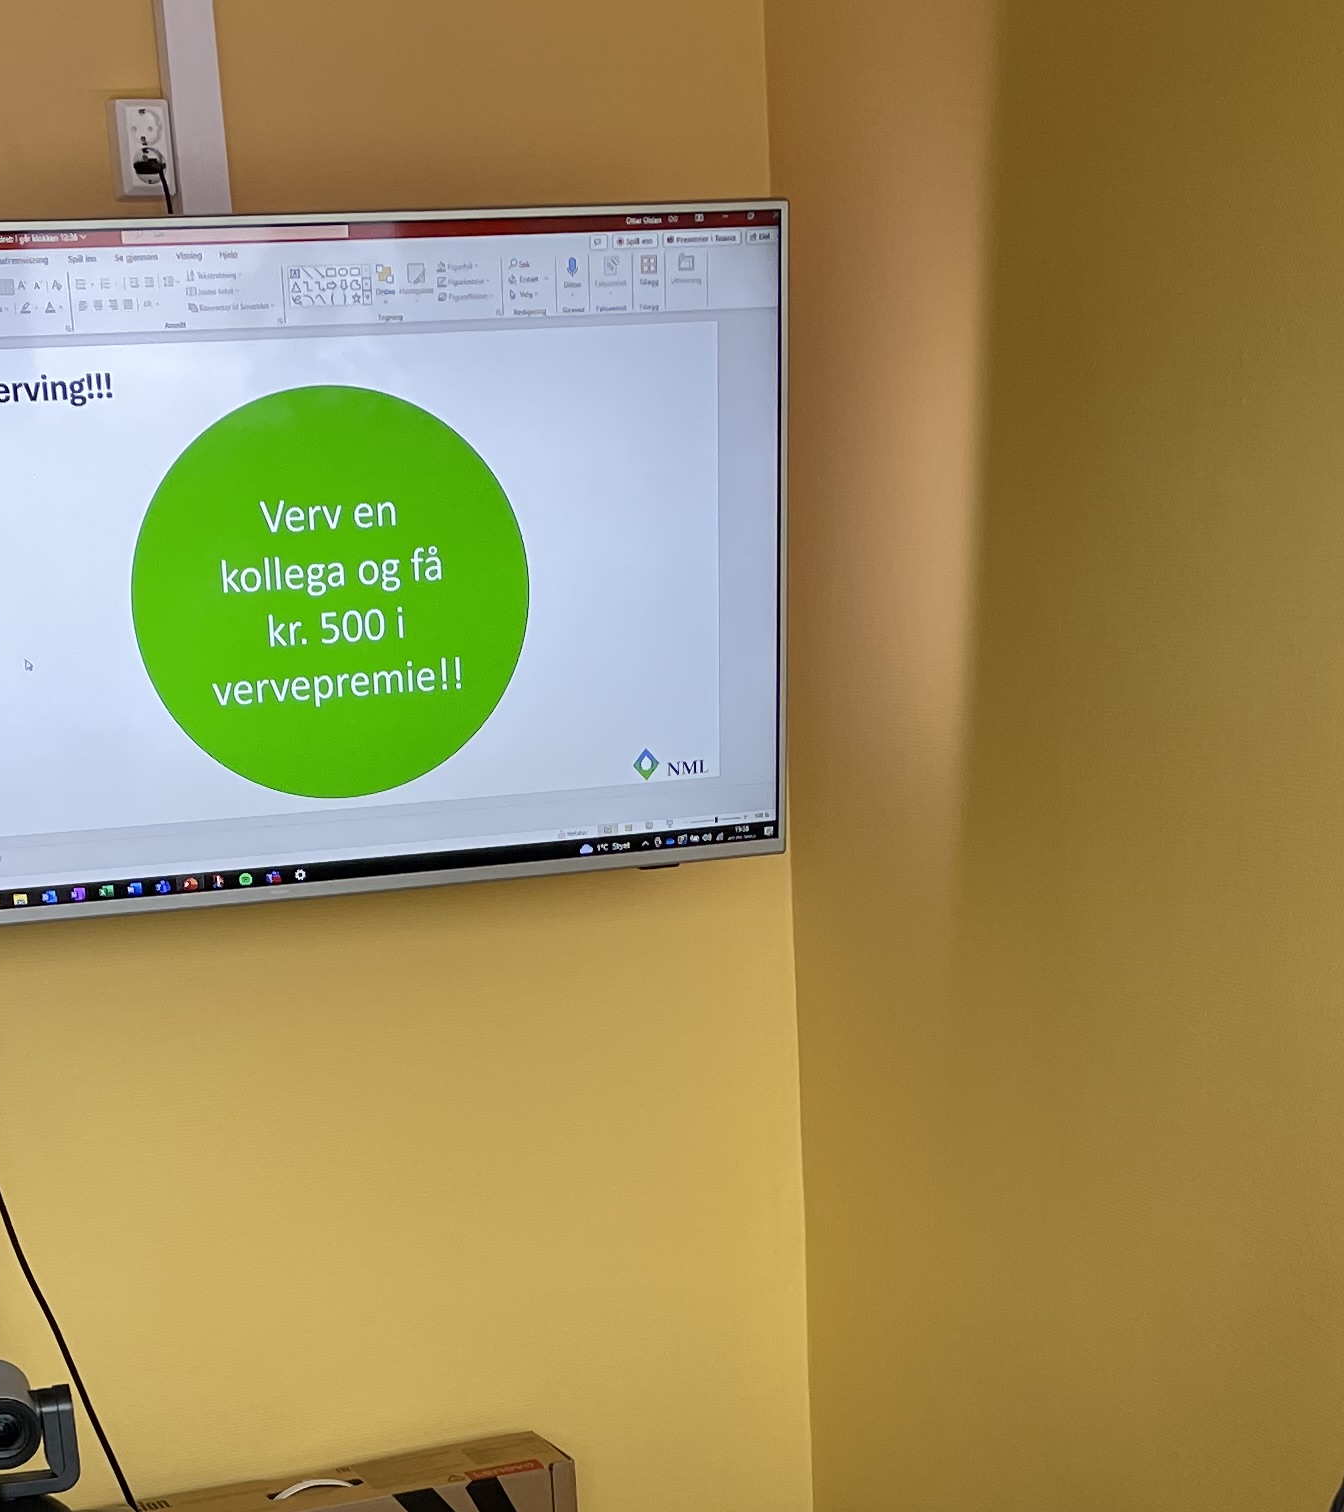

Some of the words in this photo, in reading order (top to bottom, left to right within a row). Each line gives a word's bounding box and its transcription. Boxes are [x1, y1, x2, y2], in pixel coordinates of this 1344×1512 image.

[67, 254, 84, 264] Spill
[85, 254, 97, 262] inn
[114, 254, 124, 262] Se
[125, 253, 159, 264] gjennom
[176, 251, 203, 262] Visning
[218, 250, 239, 261] Hjelp
[260, 499, 342, 533] Verv
[353, 500, 397, 529] en
[221, 557, 345, 597] kollega
[358, 561, 400, 594] og
[412, 545, 444, 583] få
[268, 614, 309, 648] kr.
[320, 609, 386, 645] 500
[397, 606, 406, 639] i
[212, 656, 463, 708] vervepremie!!
[667, 759, 709, 777] NML
